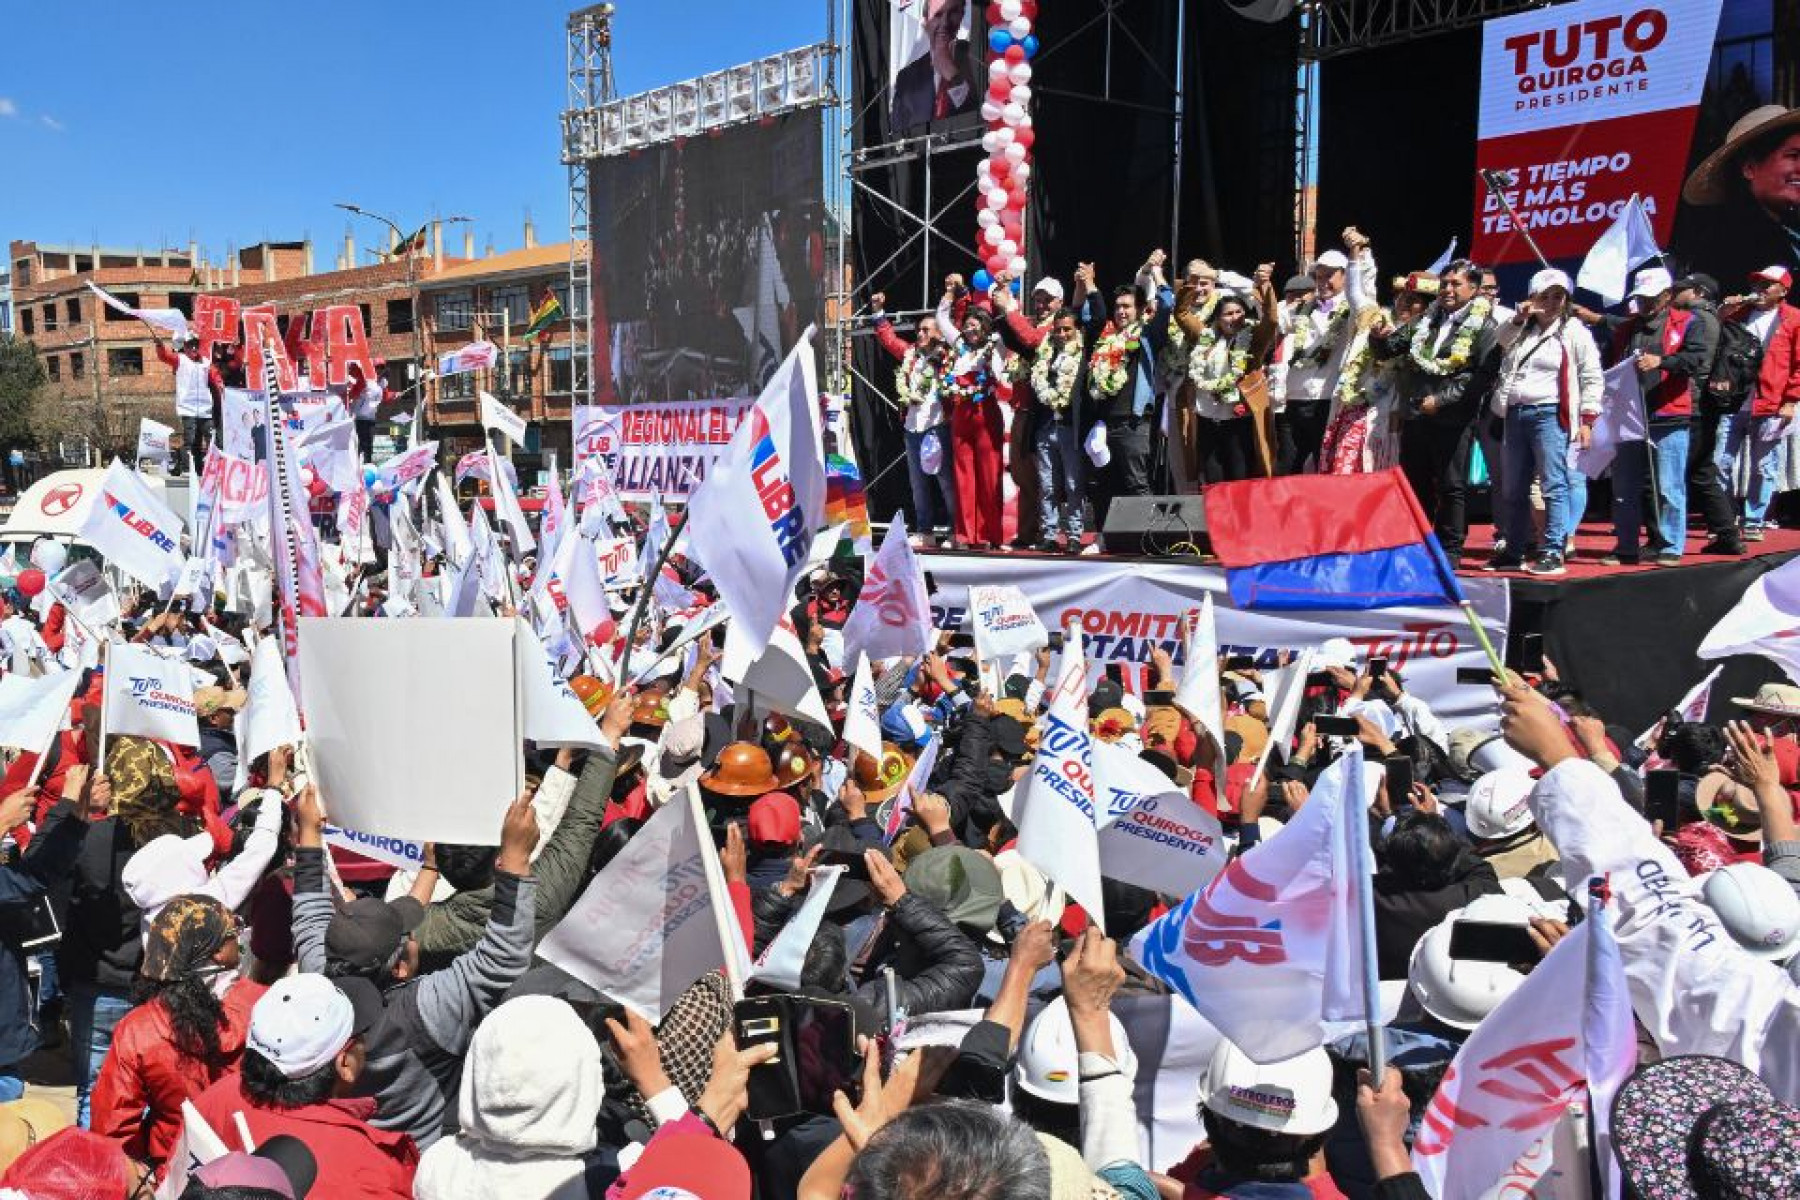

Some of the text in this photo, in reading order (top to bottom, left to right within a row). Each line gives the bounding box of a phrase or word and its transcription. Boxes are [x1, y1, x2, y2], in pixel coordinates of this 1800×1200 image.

[1504, 9, 1668, 75] TUTO
[1518, 54, 1647, 94] QUIROGA
[1515, 78, 1648, 111] PRESIDENTE
[1527, 152, 1631, 184] TIEMPO
[1484, 179, 1586, 213] DE MÁS
[1482, 196, 1657, 234] TECNOLOGA
[622, 408, 706, 443] REGIONAL
[1113, 820, 1209, 856] PRESIDENTE
[1133, 811, 1213, 847] QUIROGA
